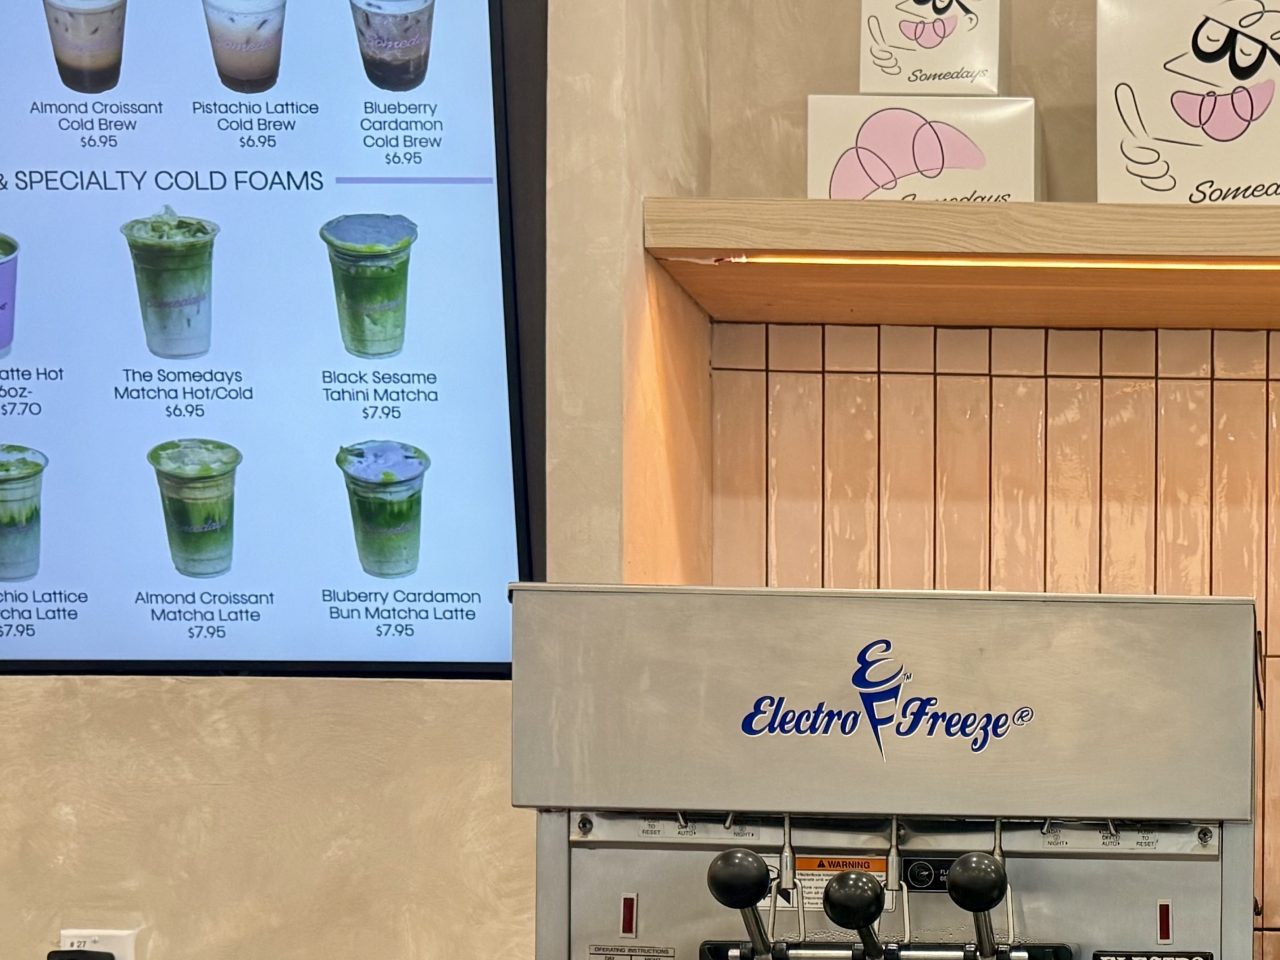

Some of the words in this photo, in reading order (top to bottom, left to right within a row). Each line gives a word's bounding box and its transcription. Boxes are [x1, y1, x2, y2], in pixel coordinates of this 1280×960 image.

[907, 66, 989, 84] Somedays
[29, 101, 89, 114] Almond
[91, 101, 164, 115] Croissant
[192, 101, 262, 115] Pistachio
[265, 101, 319, 115] Lattice
[363, 101, 438, 117] Blueberry
[58, 117, 95, 131] Cold
[98, 117, 137, 131] Brew
[217, 117, 254, 131] Cold
[257, 117, 297, 131] Brew
[360, 118, 444, 131] Cardamon
[80, 134, 118, 148] $6.95
[239, 134, 277, 149] $6.95
[362, 134, 400, 148] Cold
[403, 134, 442, 148] Brew
[384, 151, 423, 165] $6.95
[14, 170, 147, 191] SPECIALTY
[154, 170, 227, 191] COLD
[234, 170, 324, 191] FOAMS
[36, 367, 64, 381] Hot
[122, 368, 153, 383] The
[157, 368, 243, 385] Somedays
[322, 370, 369, 384] Black
[372, 370, 438, 385] Sesame
[114, 386, 179, 400] Matcha
[182, 386, 254, 401] Hot/Cold
[322, 387, 370, 402] Tahini
[373, 388, 439, 402] Matcha
[0, 402, 42, 417] $7.70
[165, 403, 205, 418] $6.95
[362, 405, 402, 420] $7.95
[32, 590, 89, 603] Lattice
[134, 591, 196, 605] Almond
[199, 591, 274, 605] Croissant
[321, 589, 389, 605] Bluberry
[393, 589, 482, 604] Cardamon
[36, 607, 78, 621] Latte
[150, 608, 215, 622] Matcha
[218, 608, 261, 622] Latte
[329, 606, 361, 620] Bun
[364, 606, 429, 620] Matcha
[433, 607, 476, 621] Latte
[187, 625, 226, 639] $7.95
[375, 623, 415, 637] $7.95
[741, 695, 862, 736] Electro
[827, 860, 871, 870] WARNING
